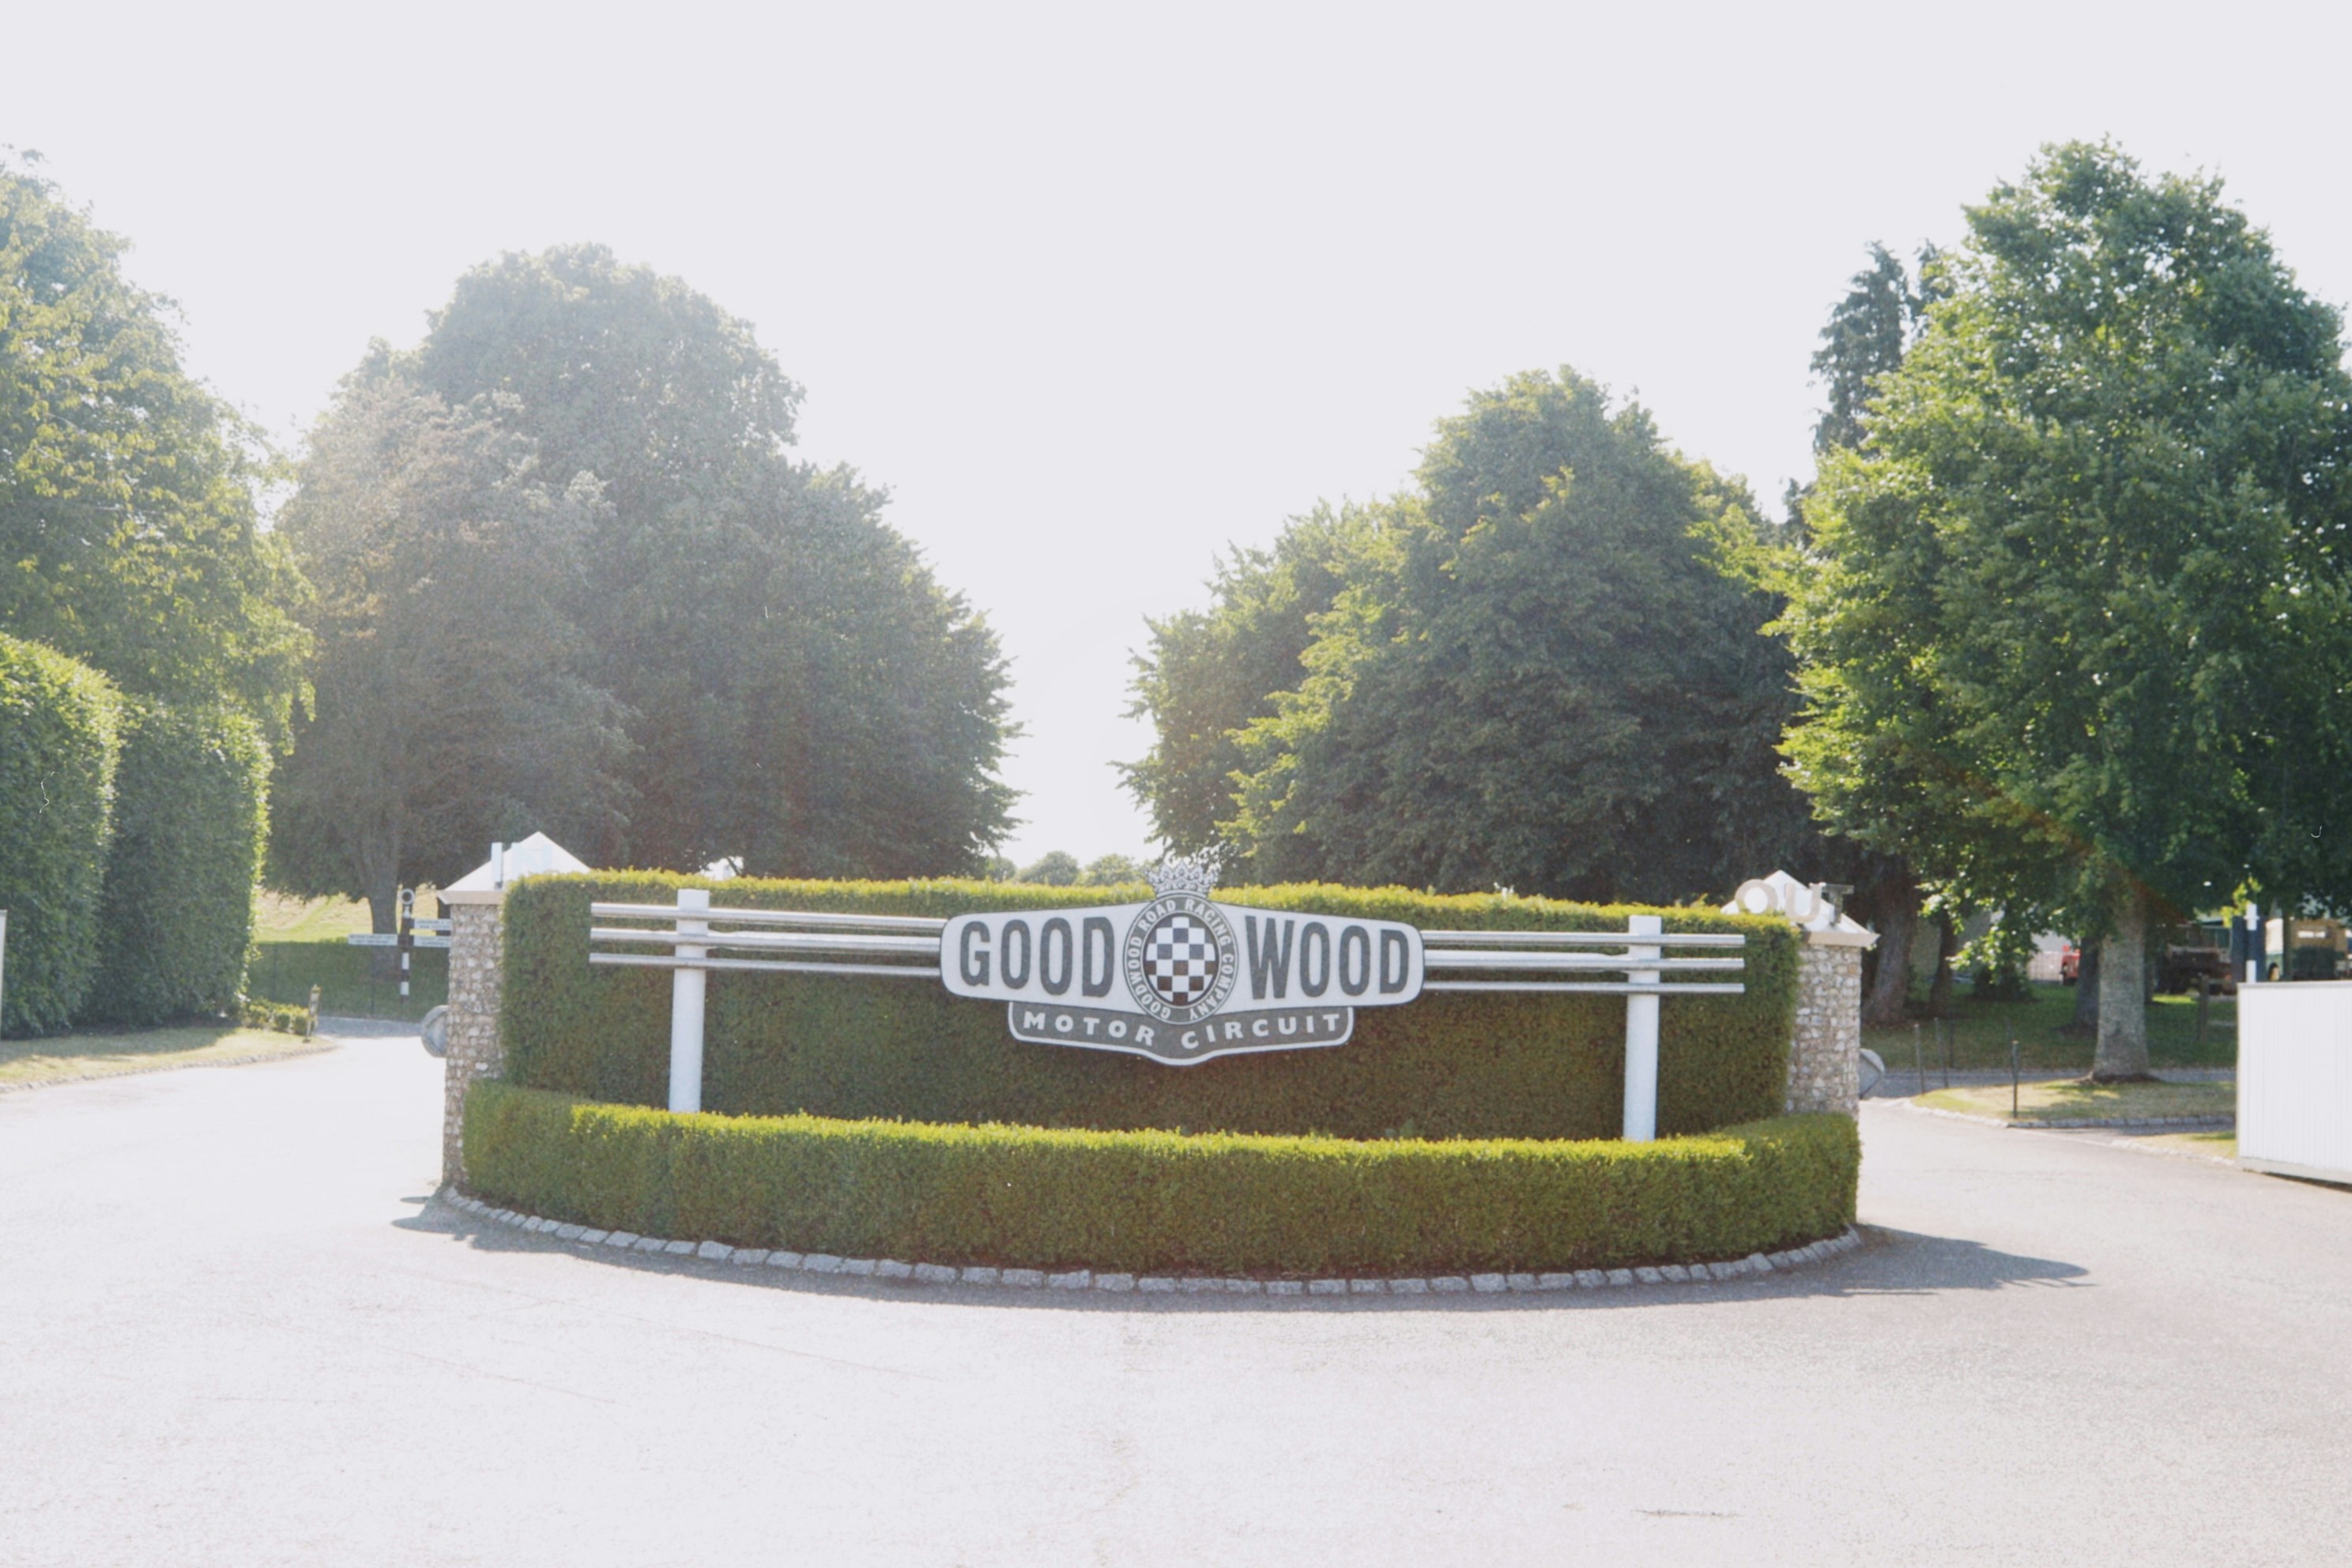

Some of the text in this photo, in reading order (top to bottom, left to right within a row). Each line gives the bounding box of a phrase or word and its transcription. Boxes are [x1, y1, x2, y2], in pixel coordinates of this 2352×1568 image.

[1735, 879, 1854, 925] OUT
[959, 915, 1409, 999] GOOD WOOD
[1128, 899, 1234, 1020] GOODWOOD ROAD RACING COMPANY
[1023, 1011, 1340, 1049] MOTOR CIRCUIT
